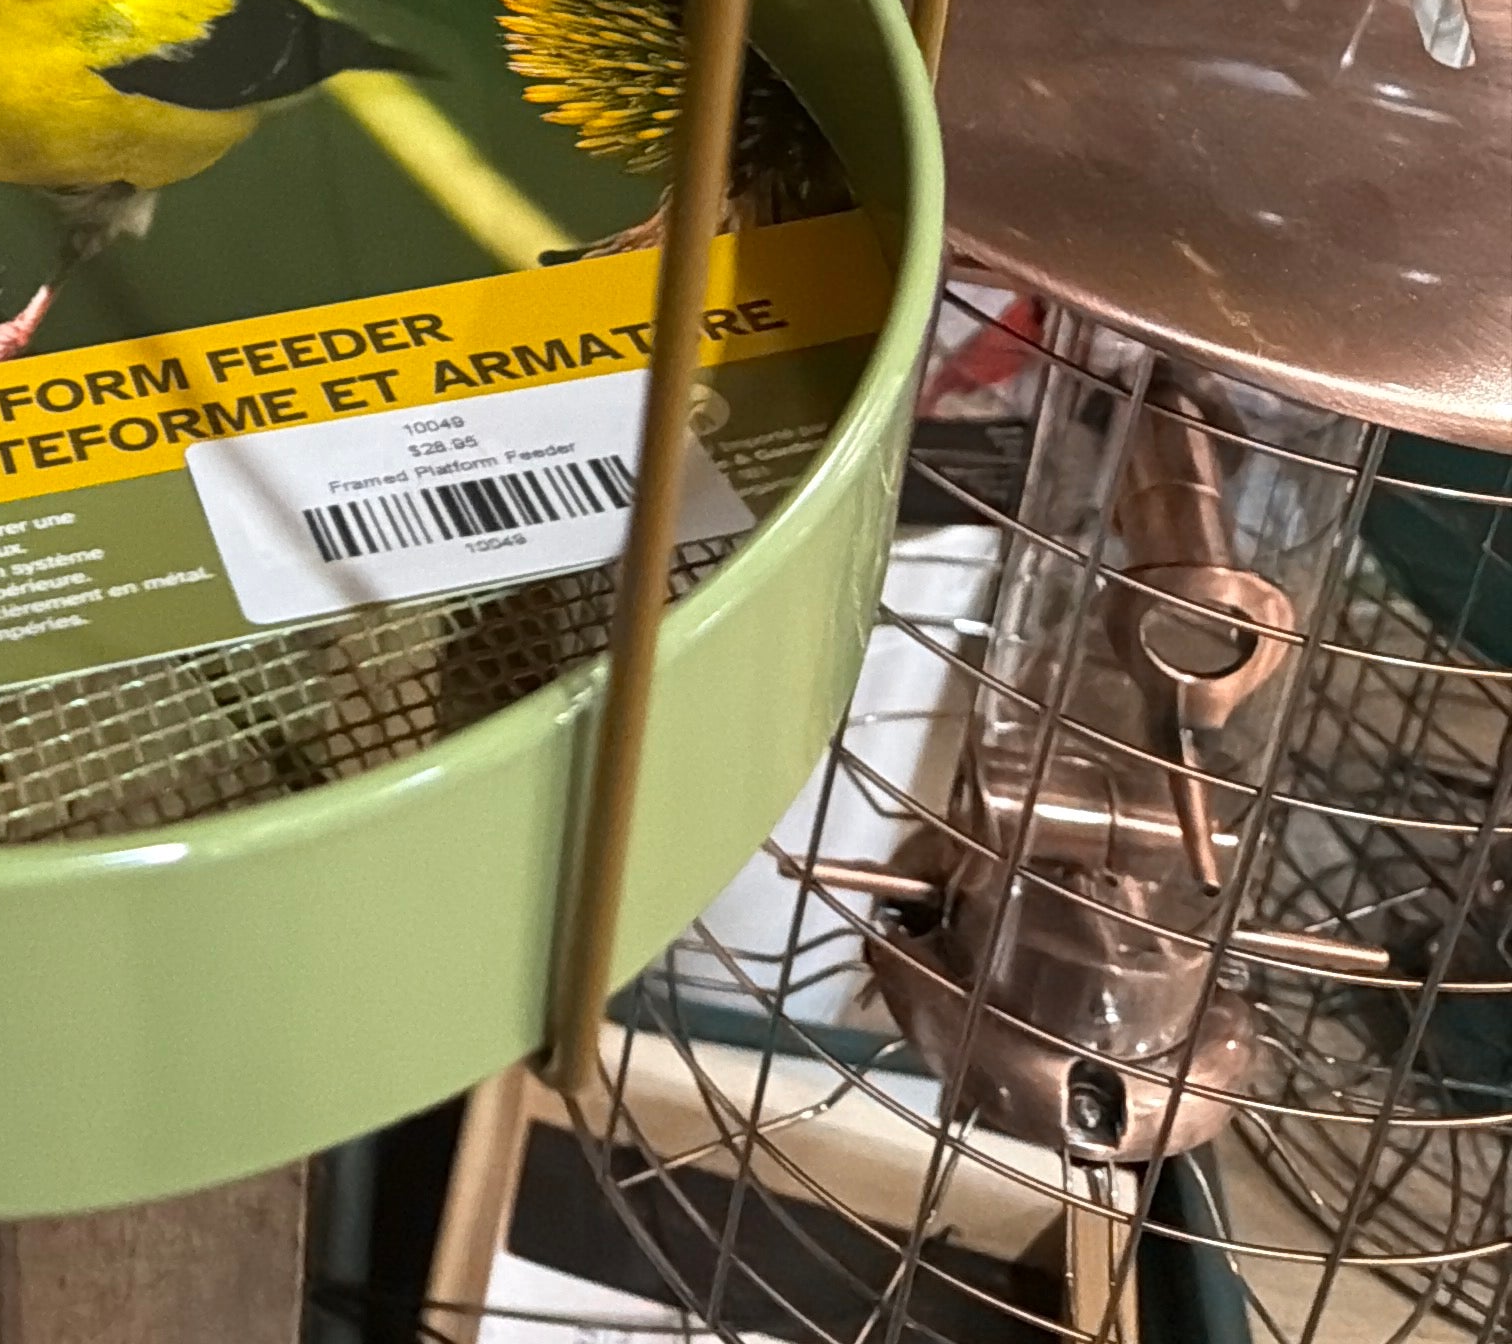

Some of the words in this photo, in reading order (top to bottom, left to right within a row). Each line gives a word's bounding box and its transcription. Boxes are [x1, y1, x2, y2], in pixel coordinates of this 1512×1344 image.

[206, 312, 454, 384] FEEDER
[321, 368, 399, 412] ET
[434, 299, 790, 394] ARMATRE
[402, 415, 465, 437] 10049
[328, 470, 409, 495] Framed
[414, 456, 498, 480] Platform
[504, 442, 576, 464] Feeder
[33, 512, 76, 530] une
[107, 582, 139, 598] en
